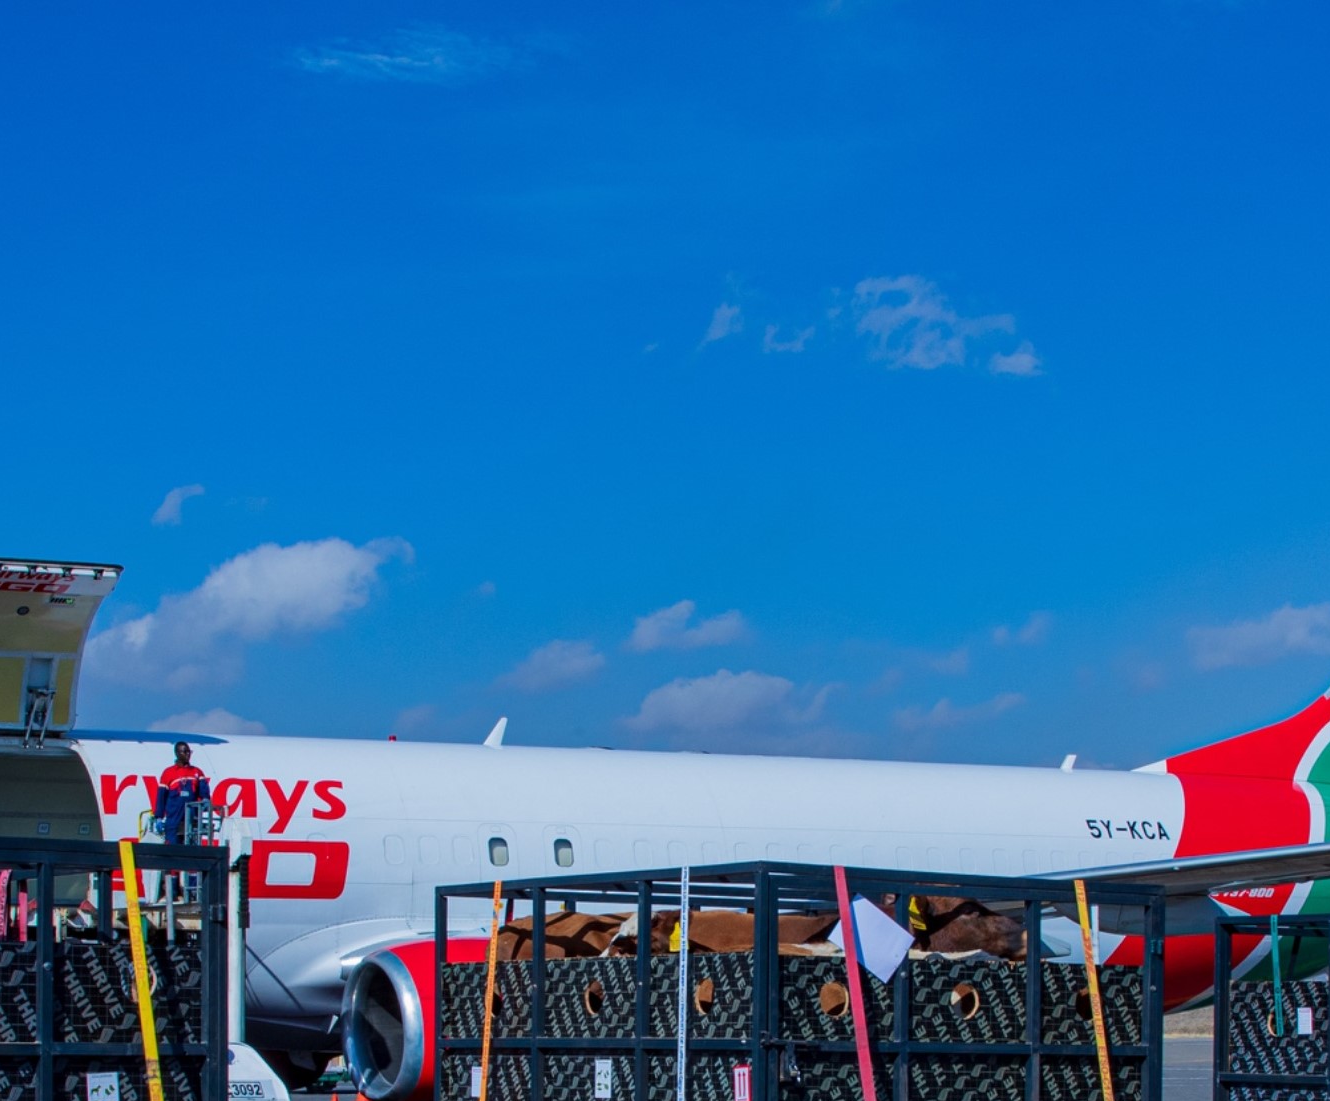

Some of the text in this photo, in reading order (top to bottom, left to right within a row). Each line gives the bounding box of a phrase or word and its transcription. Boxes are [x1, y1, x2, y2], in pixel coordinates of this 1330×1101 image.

[1085, 819, 1171, 841] 5Y-KCA
[81, 946, 124, 1019] THRIVE
[982, 976, 1013, 1037] THRIVE
[998, 965, 1027, 1026] THRIVE
[911, 1063, 930, 1098] THR
